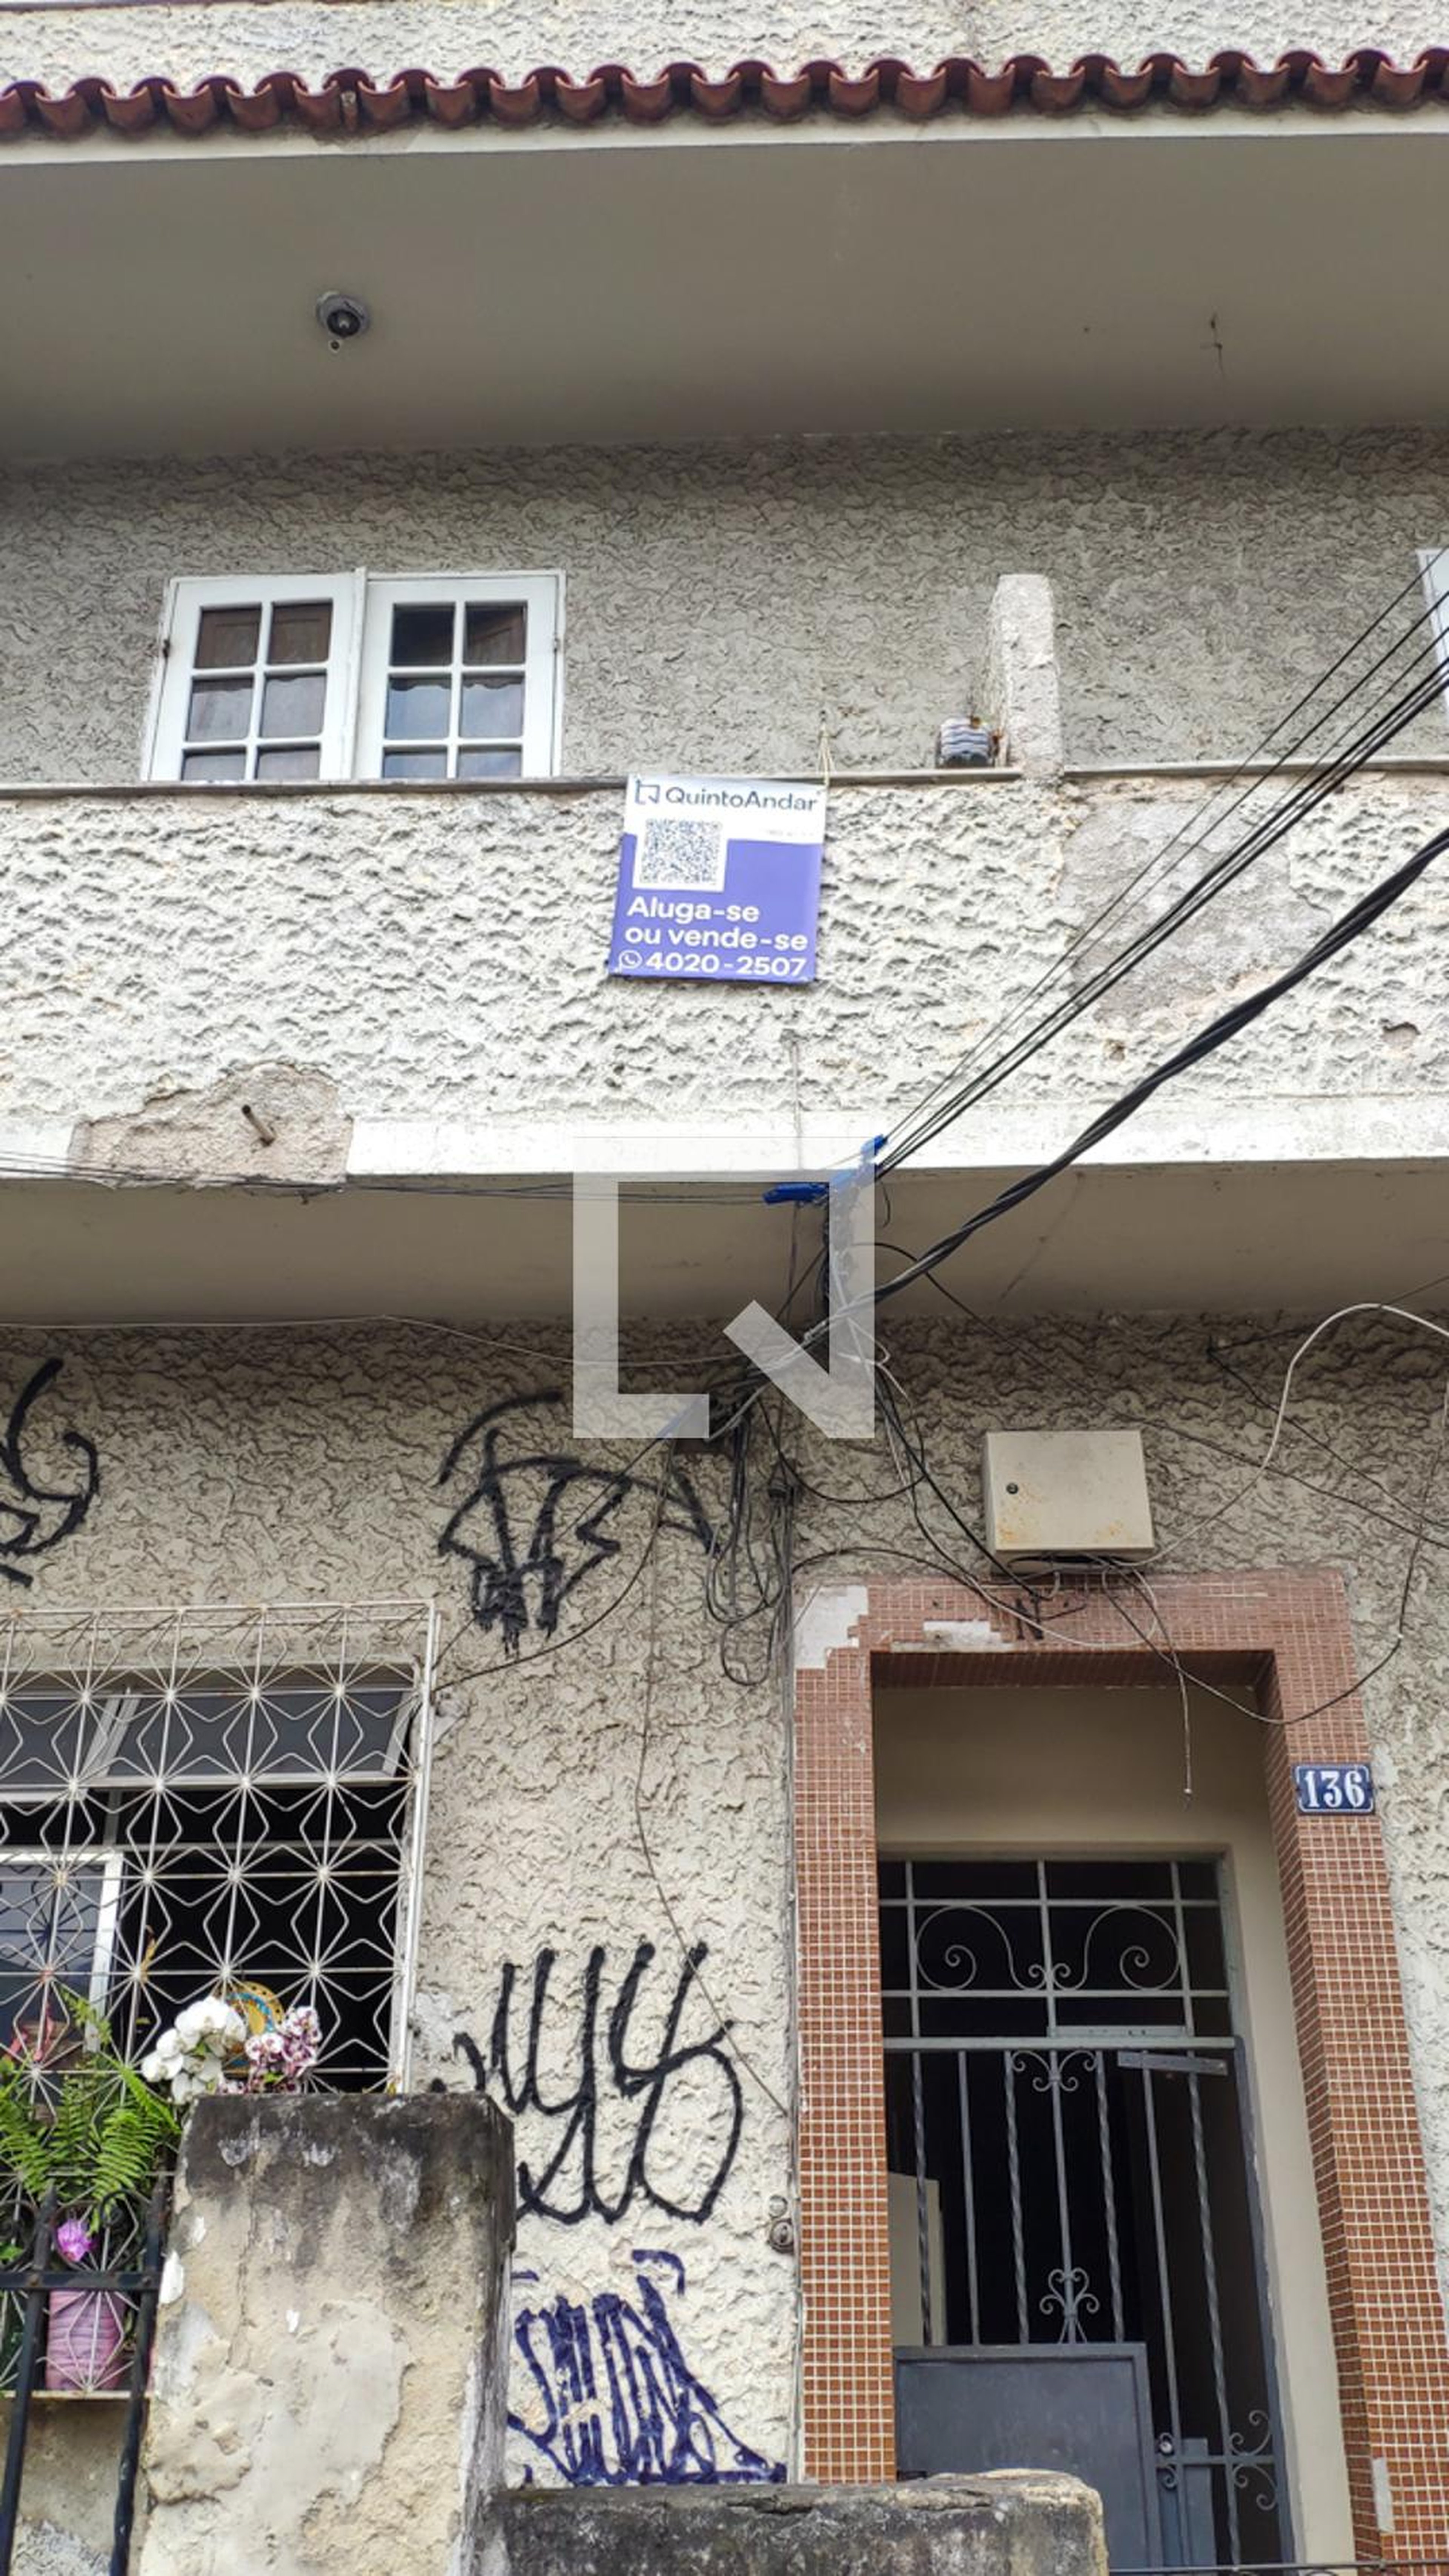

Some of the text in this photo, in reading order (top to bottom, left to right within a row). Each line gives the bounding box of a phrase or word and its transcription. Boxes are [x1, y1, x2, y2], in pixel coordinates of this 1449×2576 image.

[665, 786, 818, 811] QuintoAndar
[627, 896, 760, 924] Aluga-se
[625, 927, 808, 951] ou vende-se
[1304, 1770, 1365, 1808] 136
